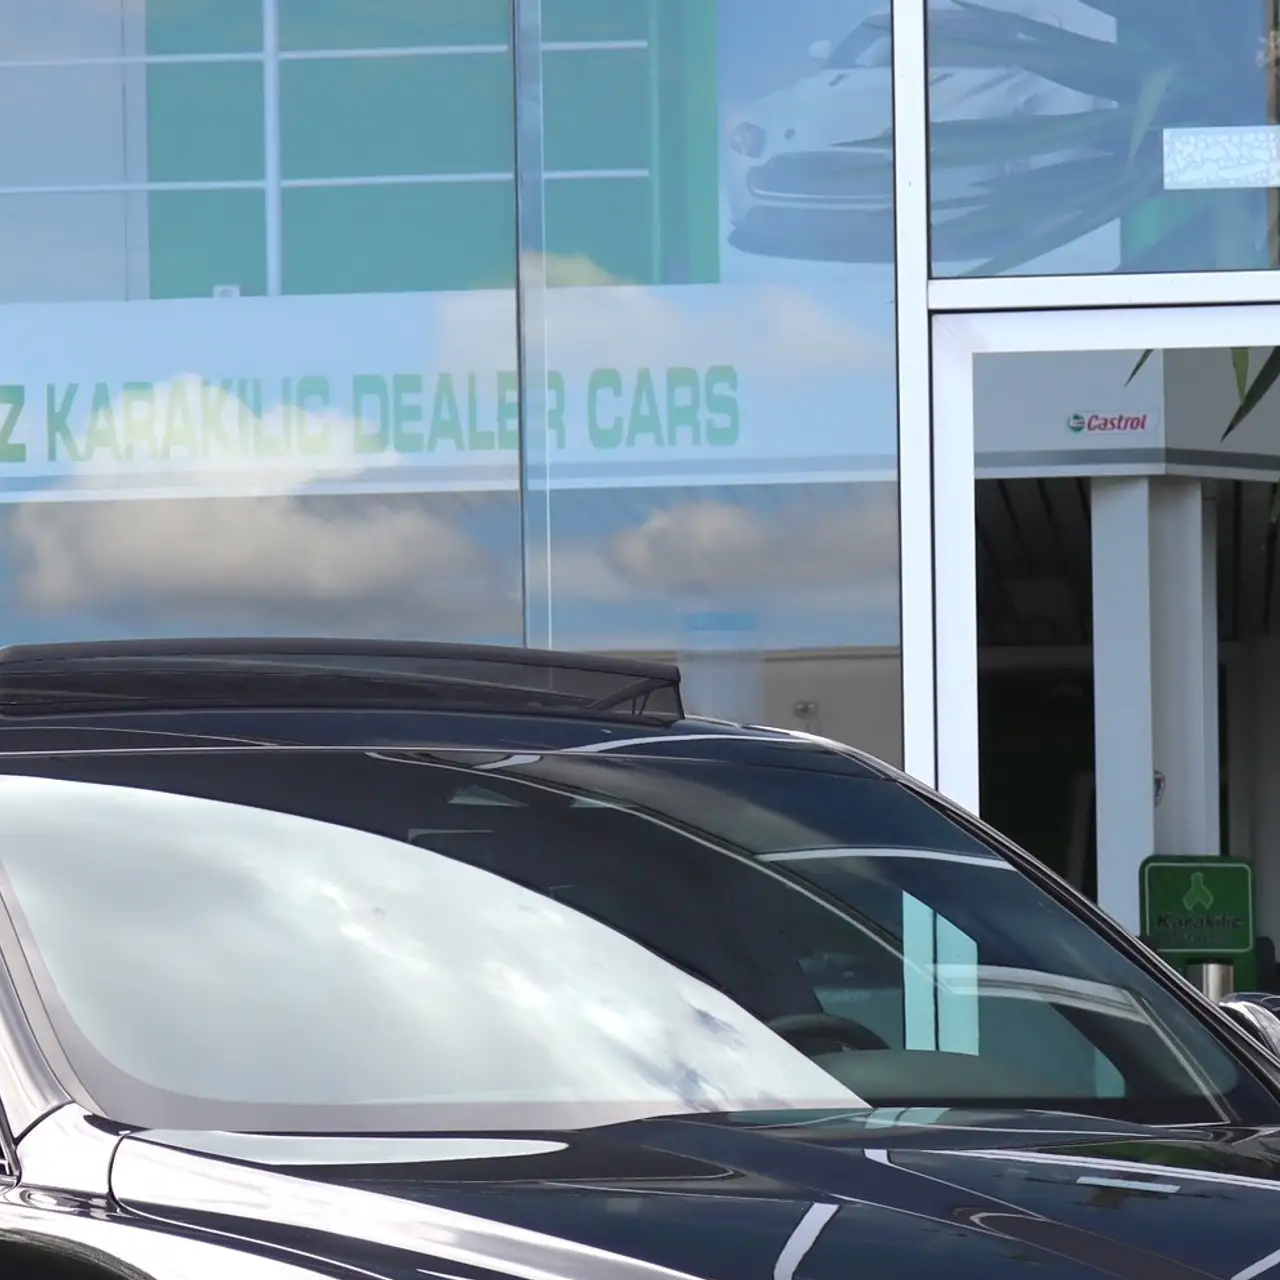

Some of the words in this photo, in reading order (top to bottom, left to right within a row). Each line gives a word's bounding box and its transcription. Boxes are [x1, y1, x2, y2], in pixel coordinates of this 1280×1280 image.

[46, 374, 331, 462] KARAKILIC
[352, 369, 567, 454] DEALER
[586, 365, 741, 450] CARS
[1087, 413, 1148, 432] Castrol
